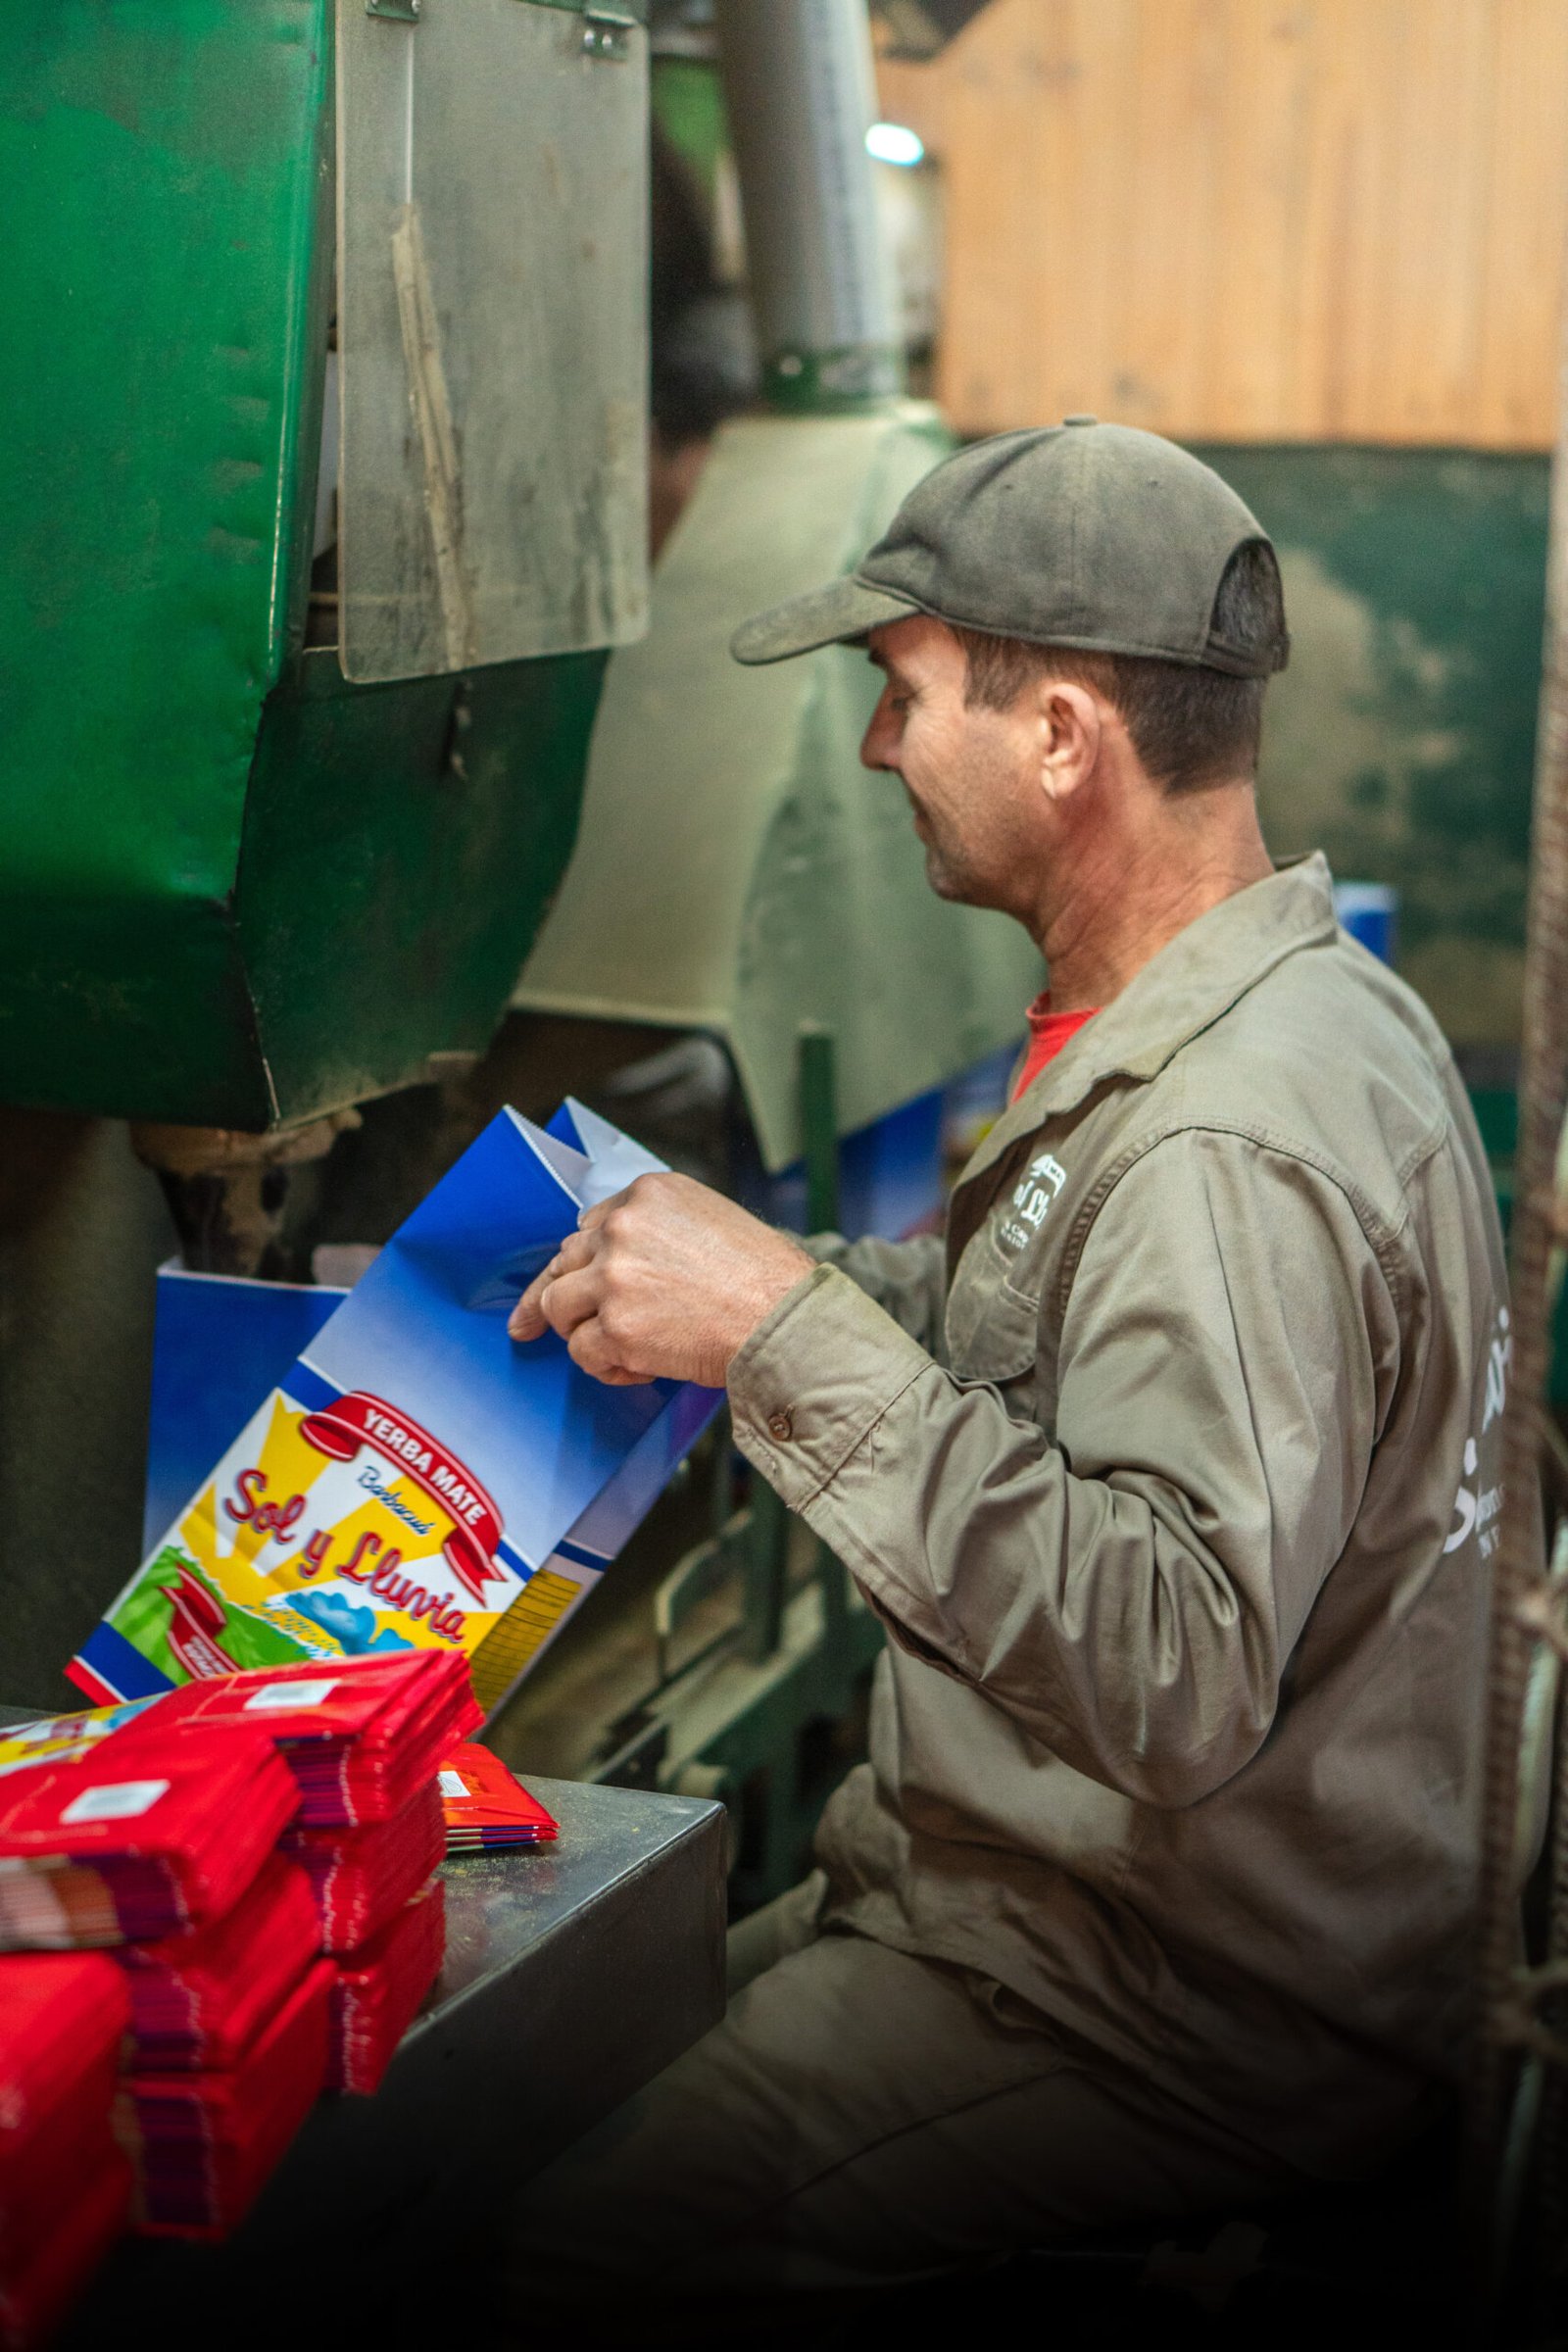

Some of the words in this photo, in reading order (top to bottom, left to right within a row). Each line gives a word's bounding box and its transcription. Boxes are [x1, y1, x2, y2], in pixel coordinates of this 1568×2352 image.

[364, 1408, 433, 1473] YERBA
[429, 1465, 488, 1526] MATE
[223, 1468, 307, 1545] Sol
[298, 1529, 334, 1579] y
[335, 1531, 467, 1643] Lluvia
